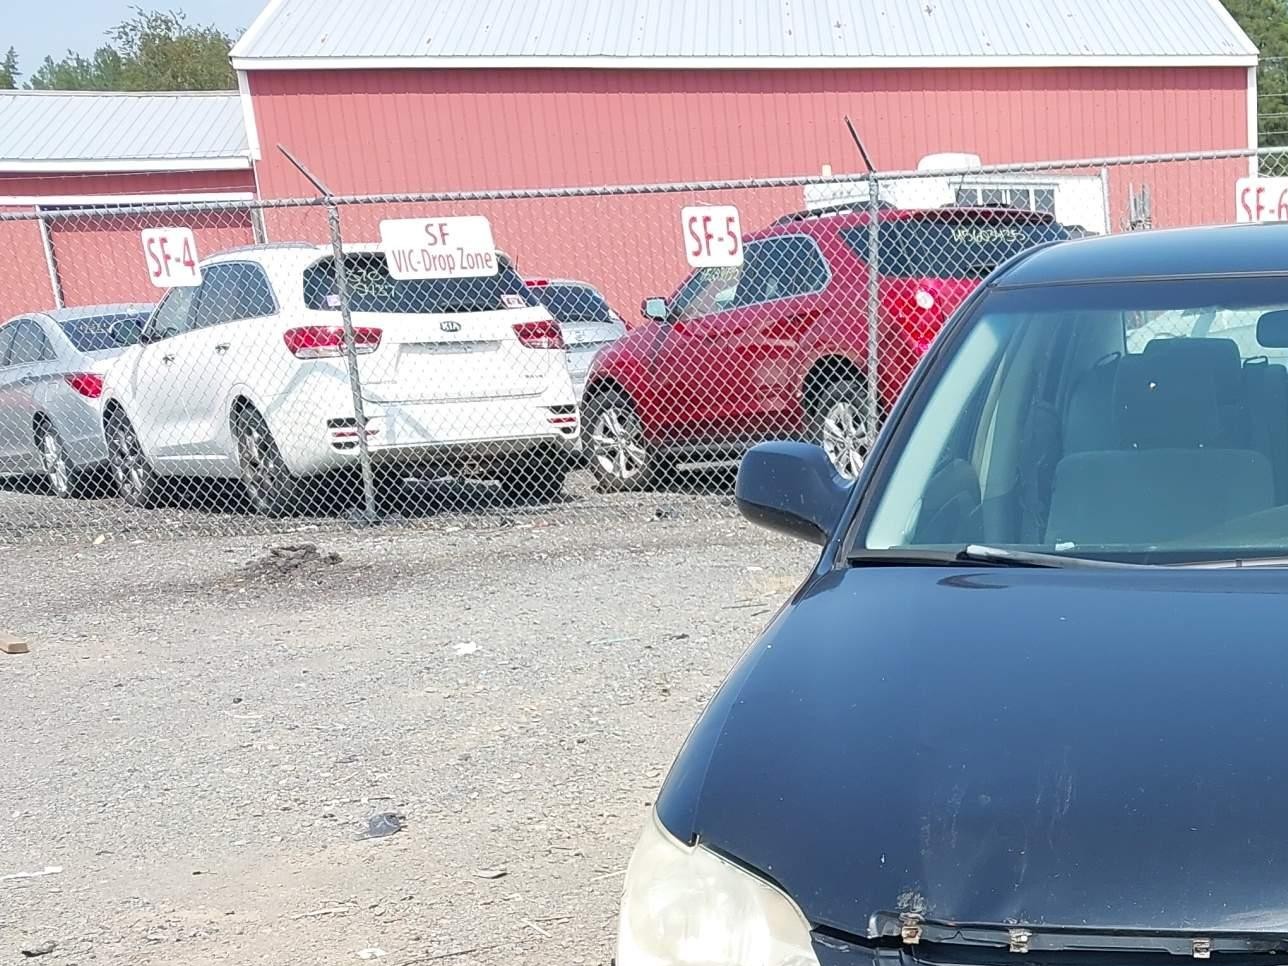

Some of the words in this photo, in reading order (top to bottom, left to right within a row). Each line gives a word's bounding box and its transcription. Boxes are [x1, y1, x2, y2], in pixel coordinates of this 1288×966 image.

[424, 223, 449, 246] SF
[688, 215, 738, 257] SF-5
[147, 236, 196, 277] SF-4
[391, 248, 456, 274] VIC-Drop
[456, 247, 493, 270] Zone
[441, 321, 461, 333] KIA
